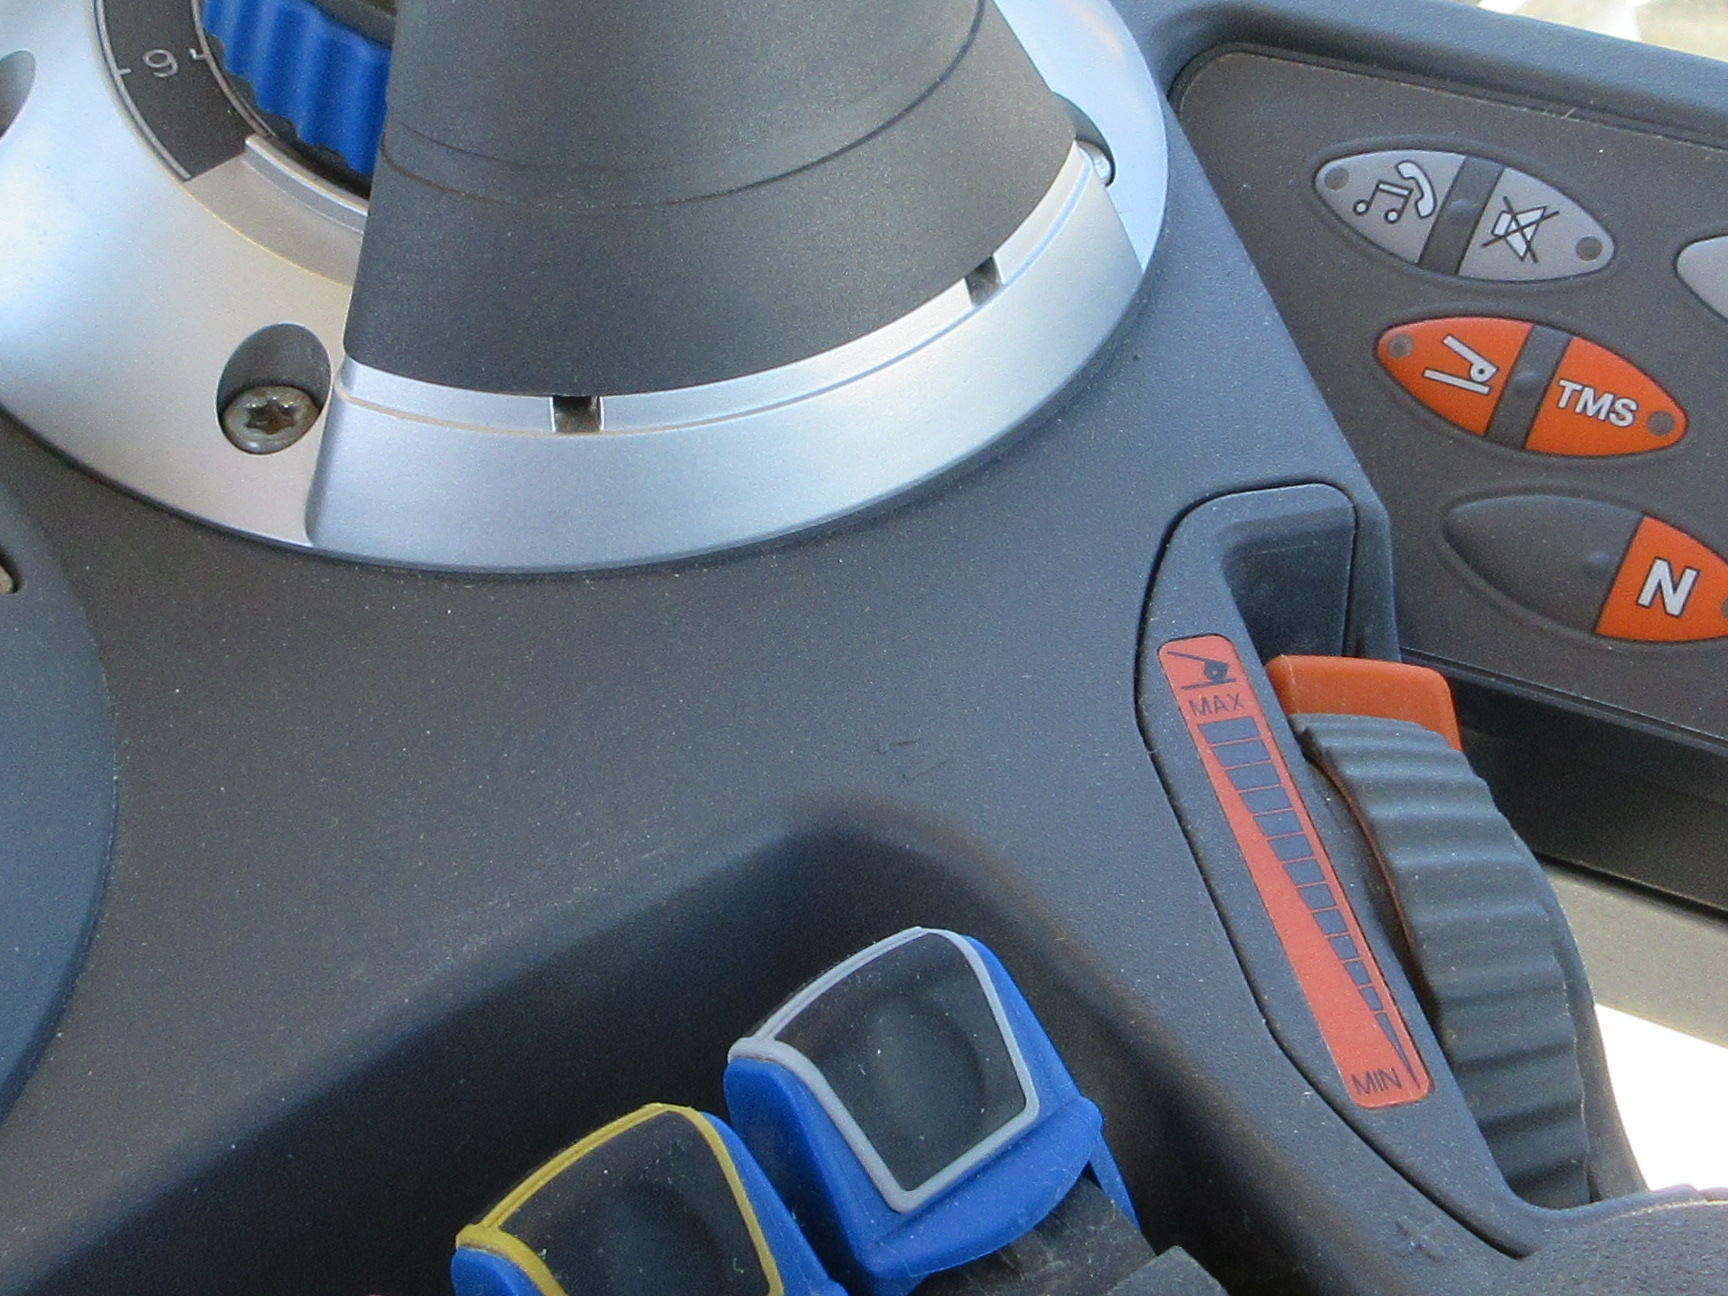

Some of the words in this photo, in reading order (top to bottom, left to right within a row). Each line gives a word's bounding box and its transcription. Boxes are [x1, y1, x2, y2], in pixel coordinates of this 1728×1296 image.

[1558, 379, 1638, 428] TMS
[1635, 556, 1701, 616] N
[1188, 691, 1247, 718] MAX
[1350, 1067, 1403, 1096] MIN
